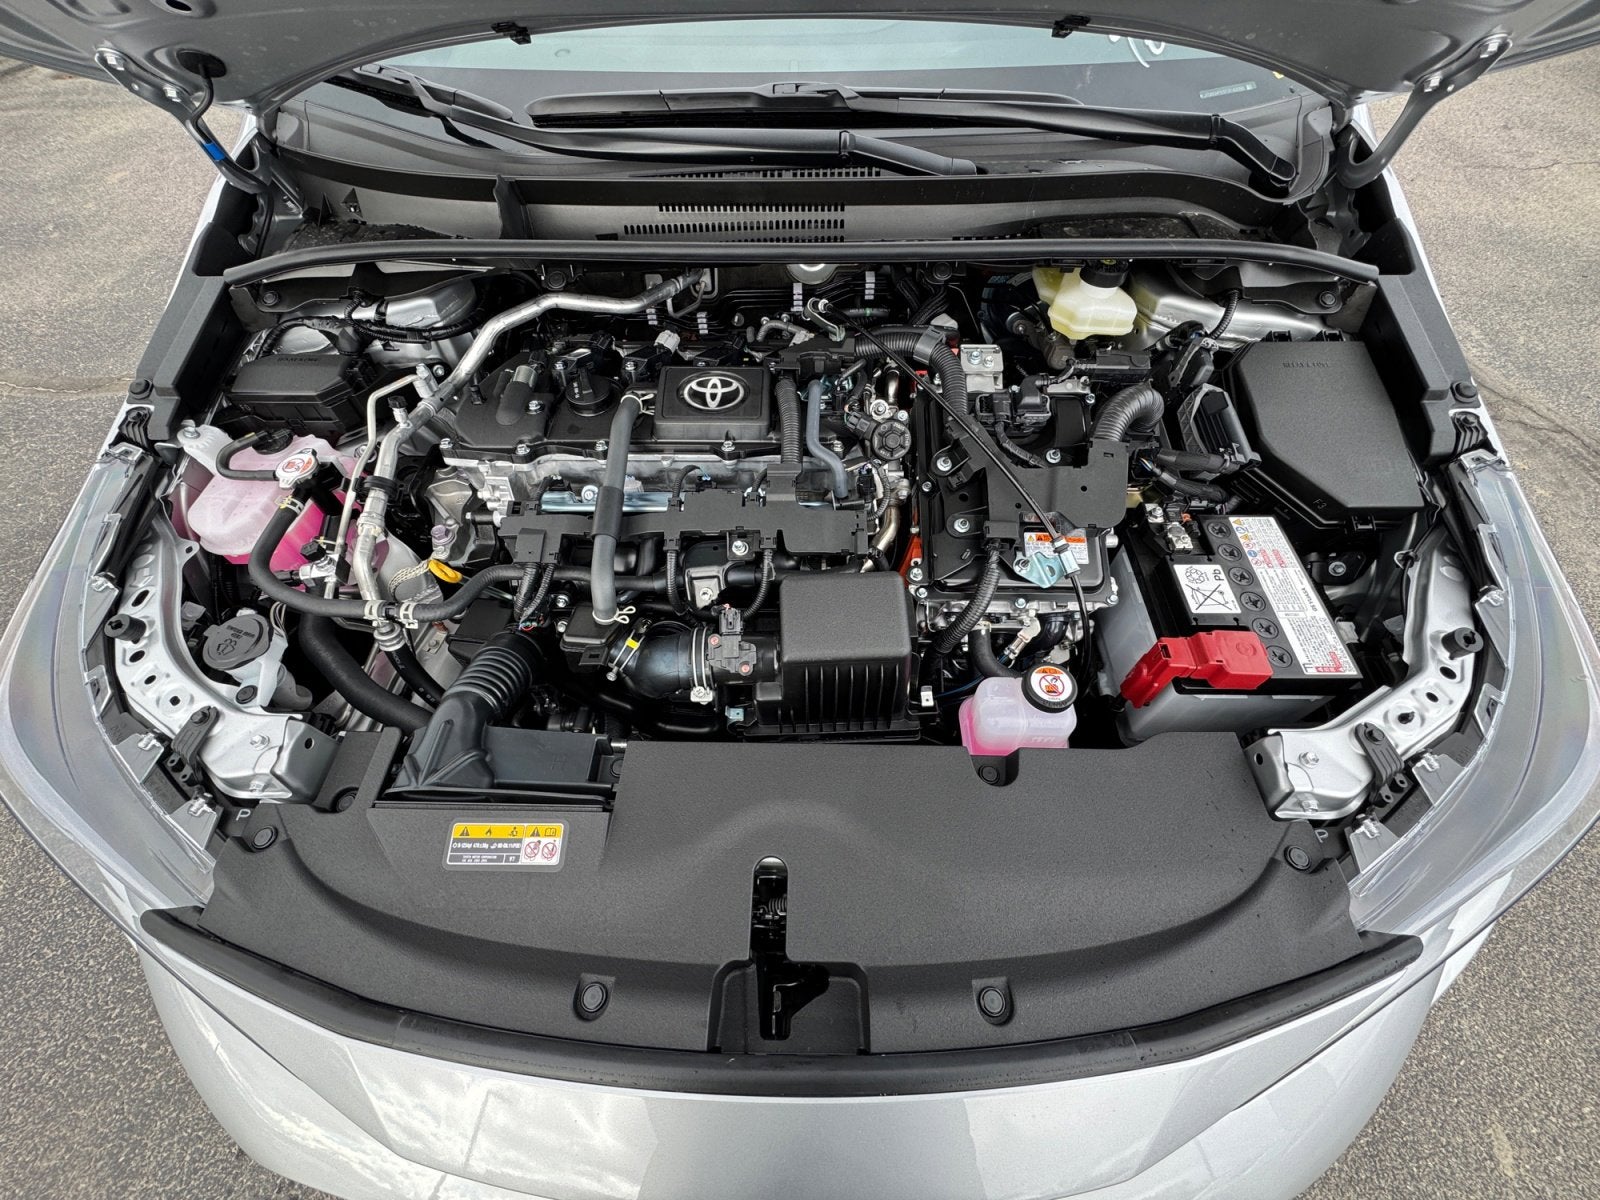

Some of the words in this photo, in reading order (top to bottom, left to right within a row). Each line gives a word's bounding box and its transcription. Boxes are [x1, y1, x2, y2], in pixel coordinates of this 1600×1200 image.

[1212, 568, 1224, 581] Pb
[235, 808, 251, 821] P
[1314, 829, 1328, 843] P
